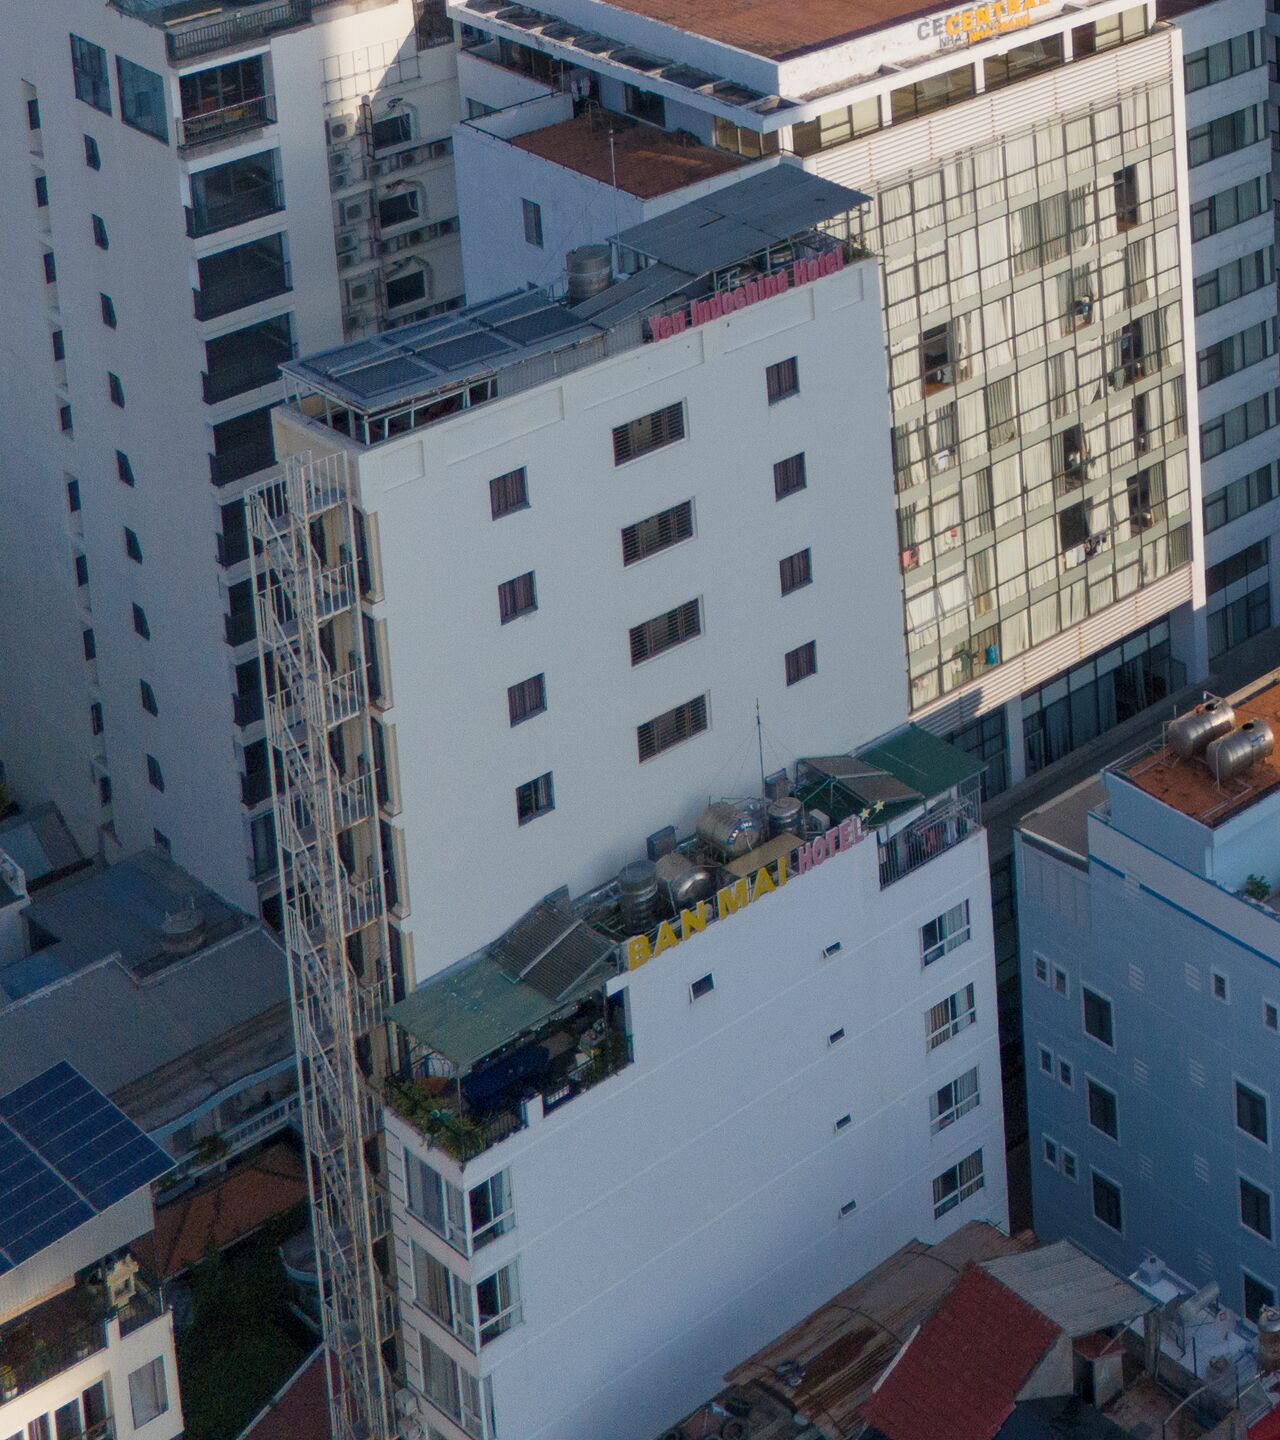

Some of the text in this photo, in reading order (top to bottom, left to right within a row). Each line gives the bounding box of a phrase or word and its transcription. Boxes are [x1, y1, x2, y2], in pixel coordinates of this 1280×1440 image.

[648, 244, 845, 343] Yen Indochine Hotel
[627, 900, 706, 971] BAN
[716, 856, 787, 921] MAI
[800, 814, 864, 875] HOTEL
